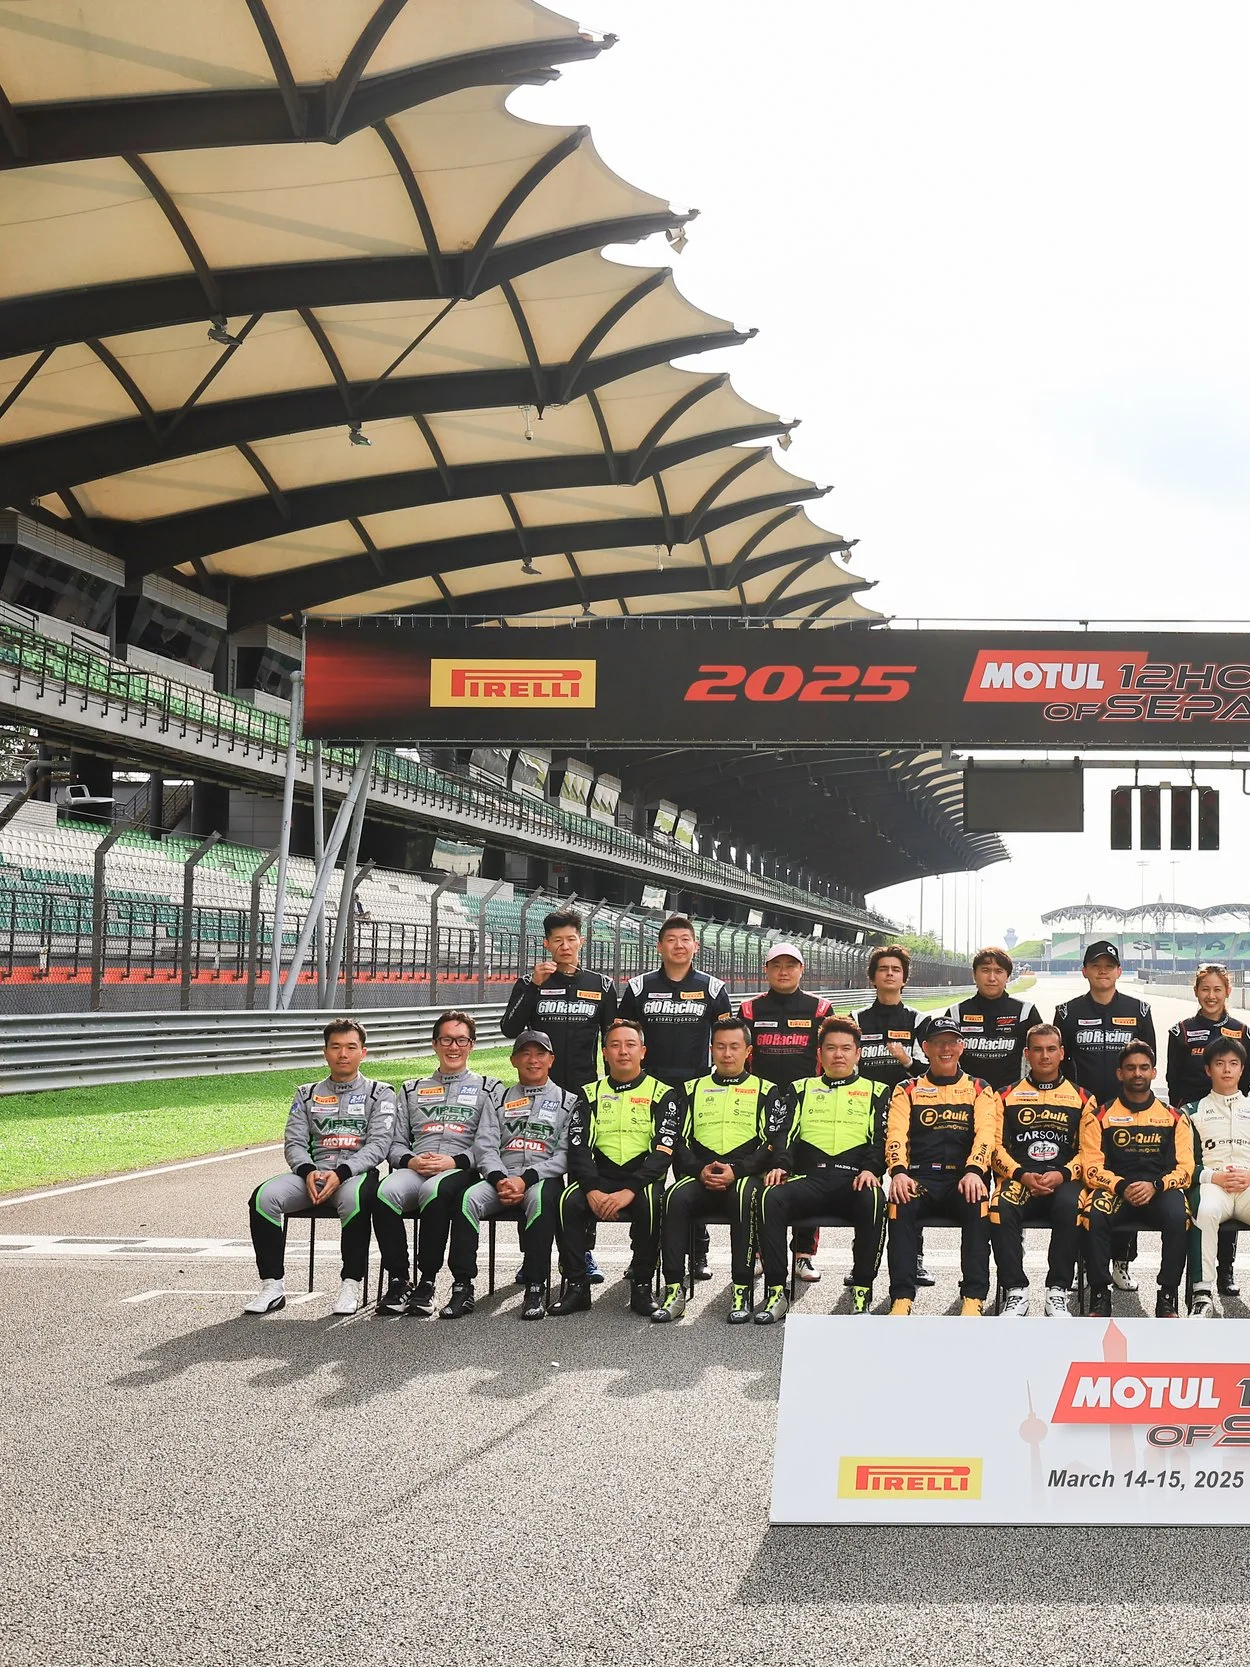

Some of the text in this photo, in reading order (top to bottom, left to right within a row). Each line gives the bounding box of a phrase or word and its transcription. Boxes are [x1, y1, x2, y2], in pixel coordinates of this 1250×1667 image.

[451, 669, 580, 698] PIRELLI
[684, 665, 917, 702] 2025
[980, 662, 1105, 690] MOTUL
[1042, 701, 1102, 722] OF
[420, 1106, 475, 1119] VIPER
[312, 1118, 368, 1132] VIPER
[323, 1137, 358, 1146] MOTUL
[508, 1139, 543, 1150] MOTUL
[1016, 1130, 1069, 1144] CARSOME
[1071, 1376, 1221, 1409] MOTUL
[1146, 1423, 1217, 1448] OF
[854, 1465, 969, 1492] PIRELLI
[1048, 1470, 1115, 1488] March
[1122, 1471, 1187, 1491] 14-15,
[1194, 1471, 1244, 1488] 2025
